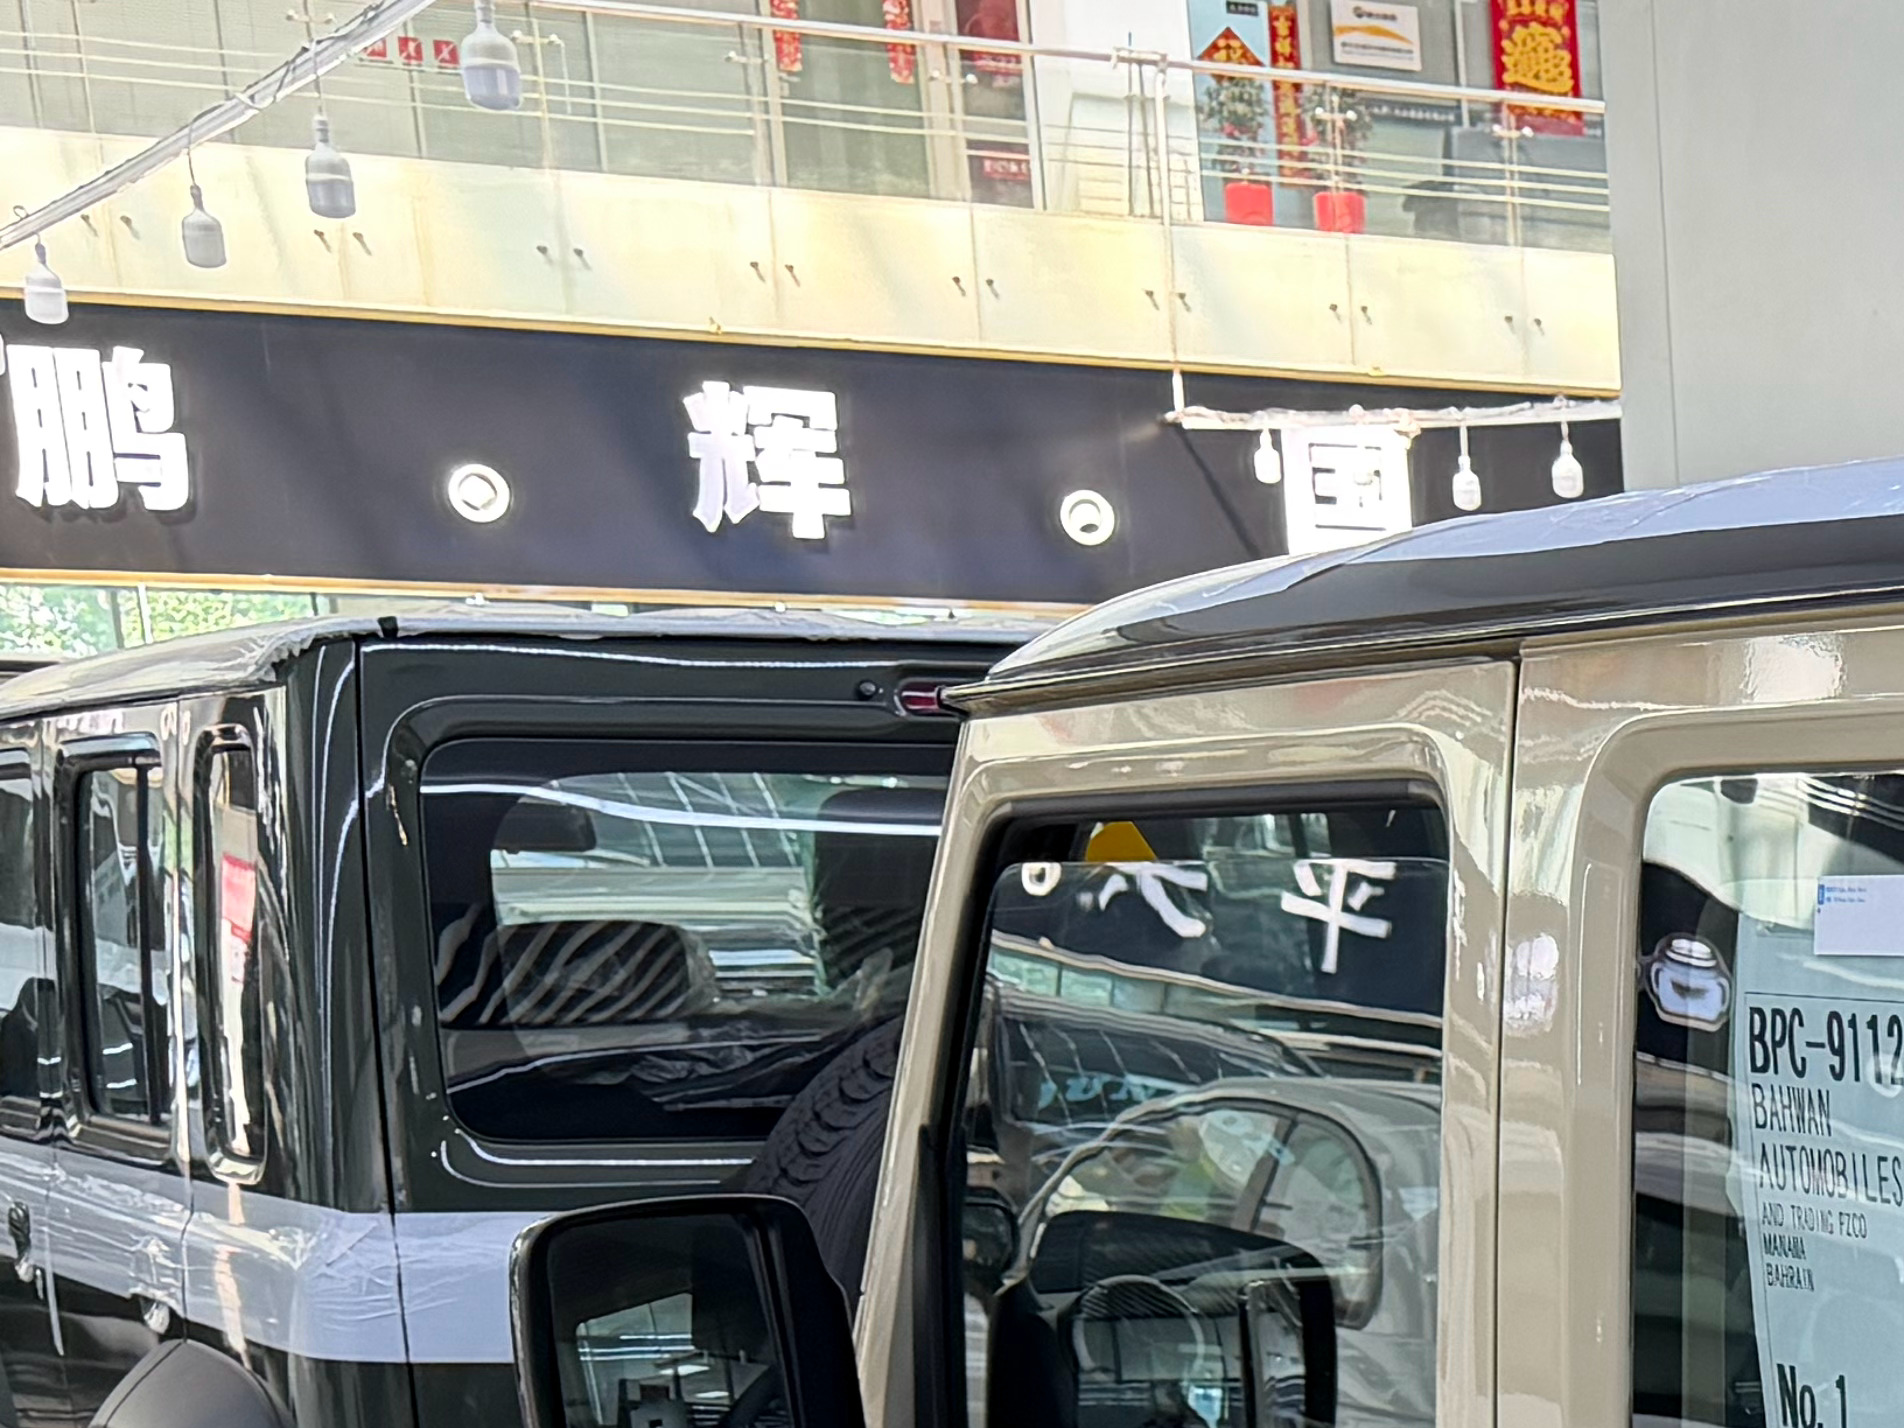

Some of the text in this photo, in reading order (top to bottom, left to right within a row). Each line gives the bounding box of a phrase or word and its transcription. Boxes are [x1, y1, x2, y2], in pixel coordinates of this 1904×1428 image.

[1748, 1006, 1904, 1087] BPC-9112
[1752, 1083, 1832, 1137] BAHWAN
[1759, 1142, 1904, 1208] AUTOMOBILES
[1762, 1202, 1867, 1239] AND TRADING FZCO
